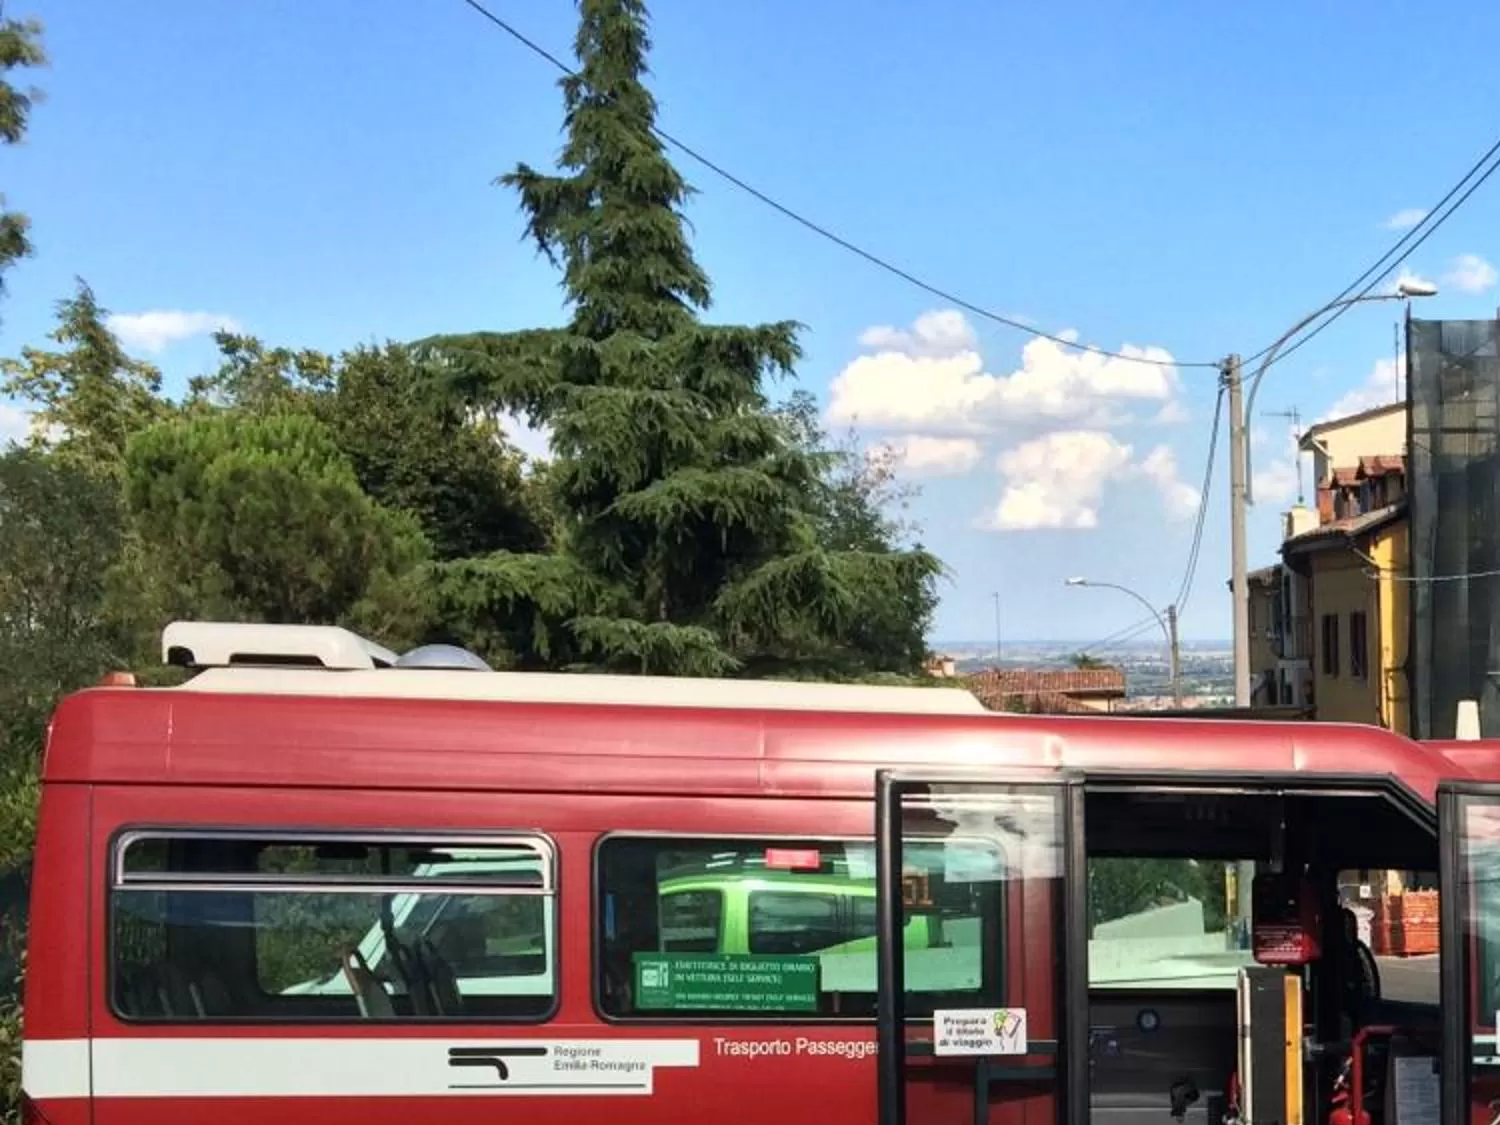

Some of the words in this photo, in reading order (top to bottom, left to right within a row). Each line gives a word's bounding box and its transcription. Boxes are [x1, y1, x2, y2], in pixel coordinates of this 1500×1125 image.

[713, 1037, 791, 1060] Trasporto
[953, 1039, 992, 1049] viaggio
[553, 1046, 602, 1059] Regione
